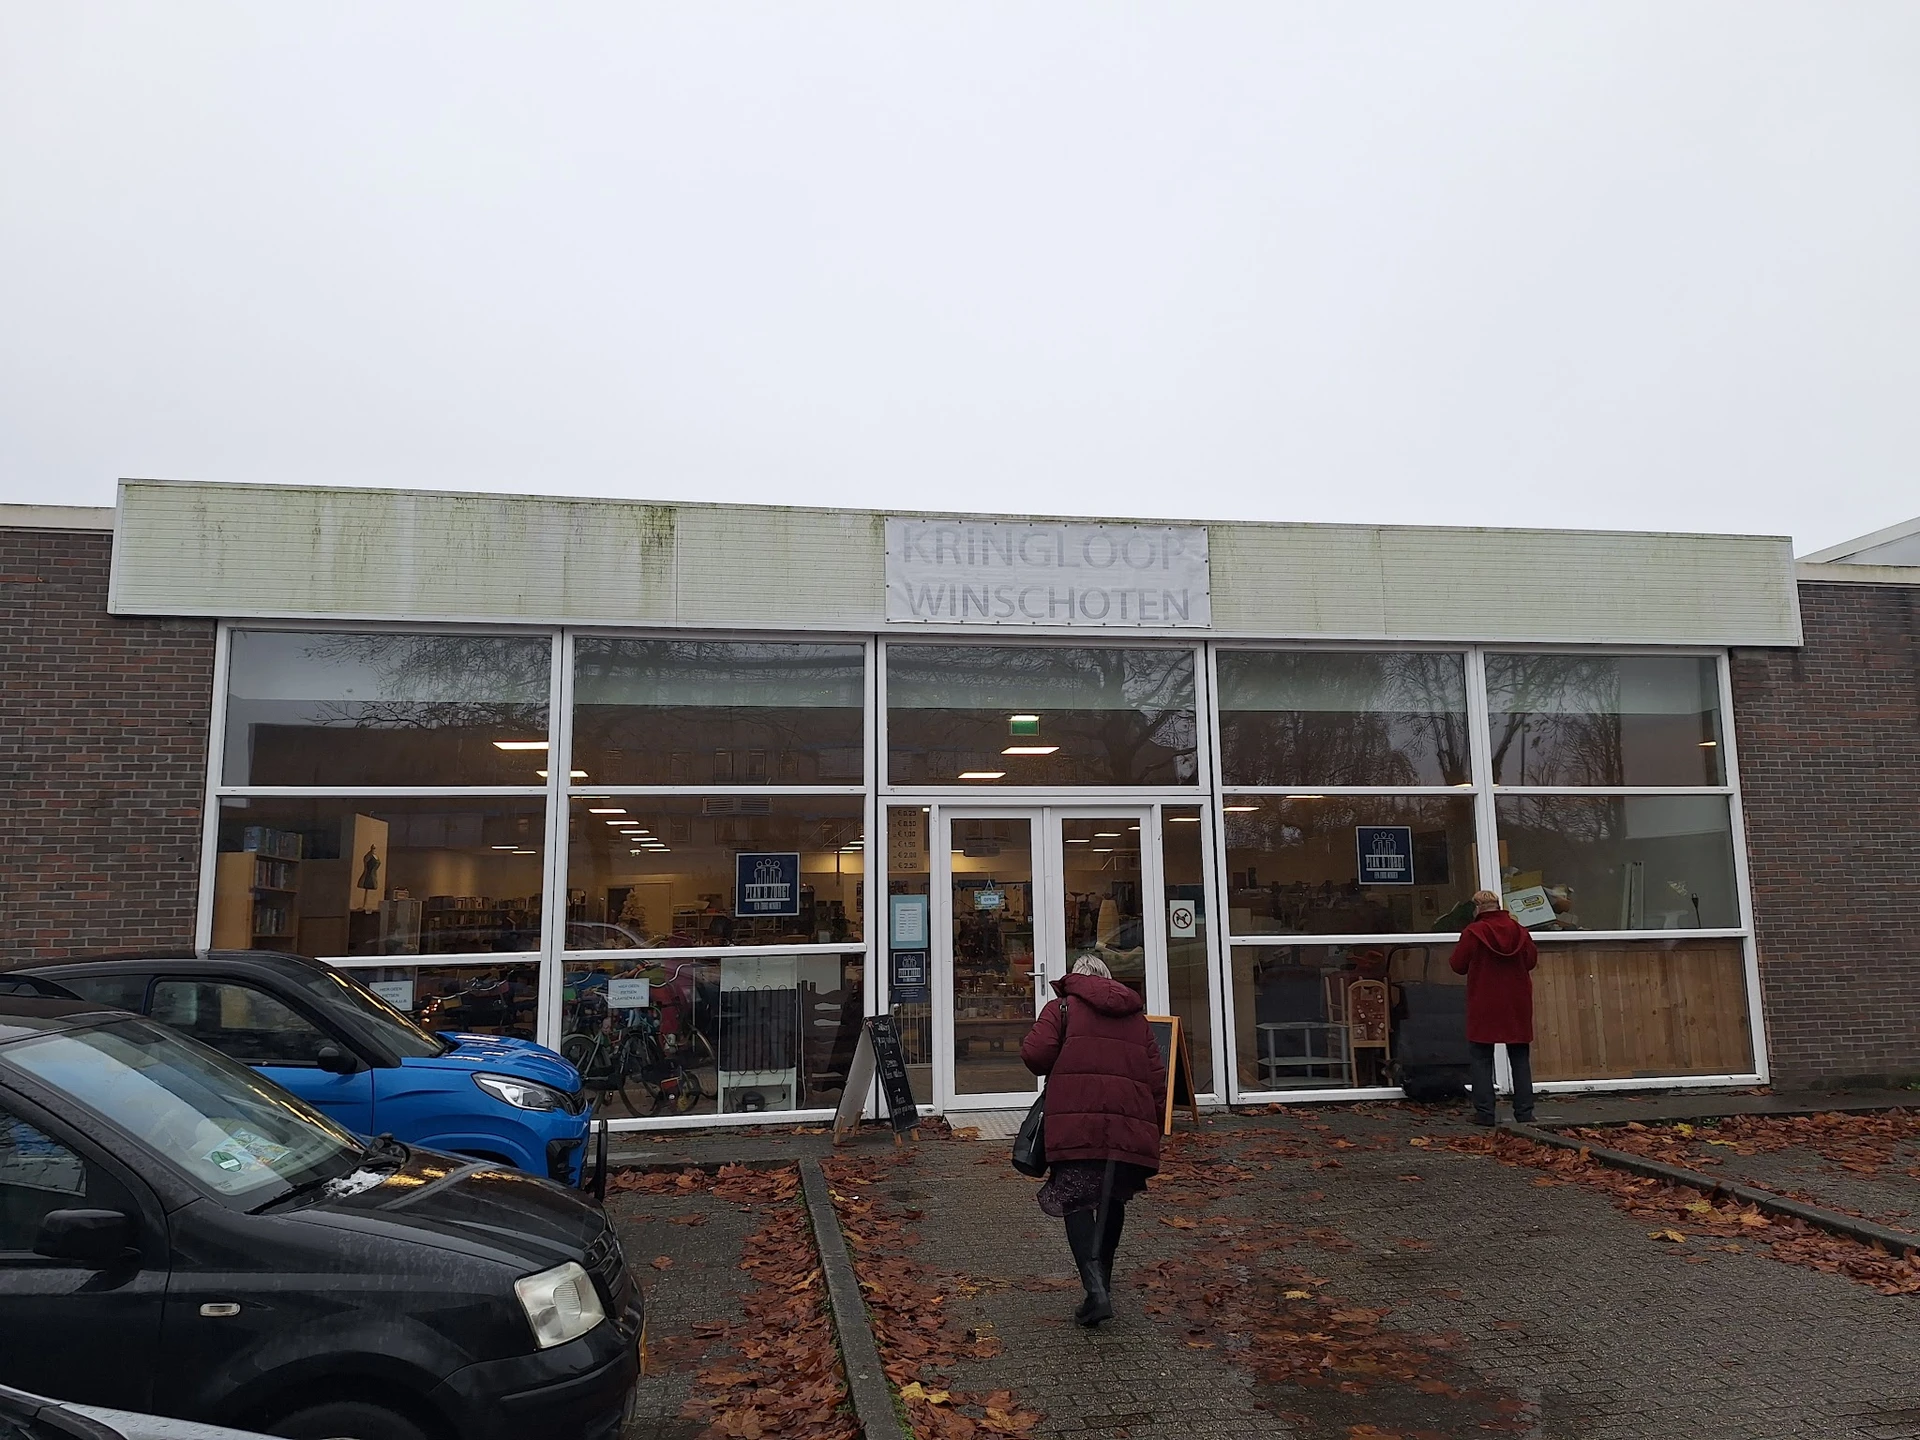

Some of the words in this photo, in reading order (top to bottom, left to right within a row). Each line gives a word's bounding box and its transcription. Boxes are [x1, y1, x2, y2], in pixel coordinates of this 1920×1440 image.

[903, 524, 1187, 570] KRINGLOOP
[904, 582, 1190, 621] WINSCHOTEN
[746, 886, 761, 898] PLAN
[770, 886, 790, 898] ZORGT
